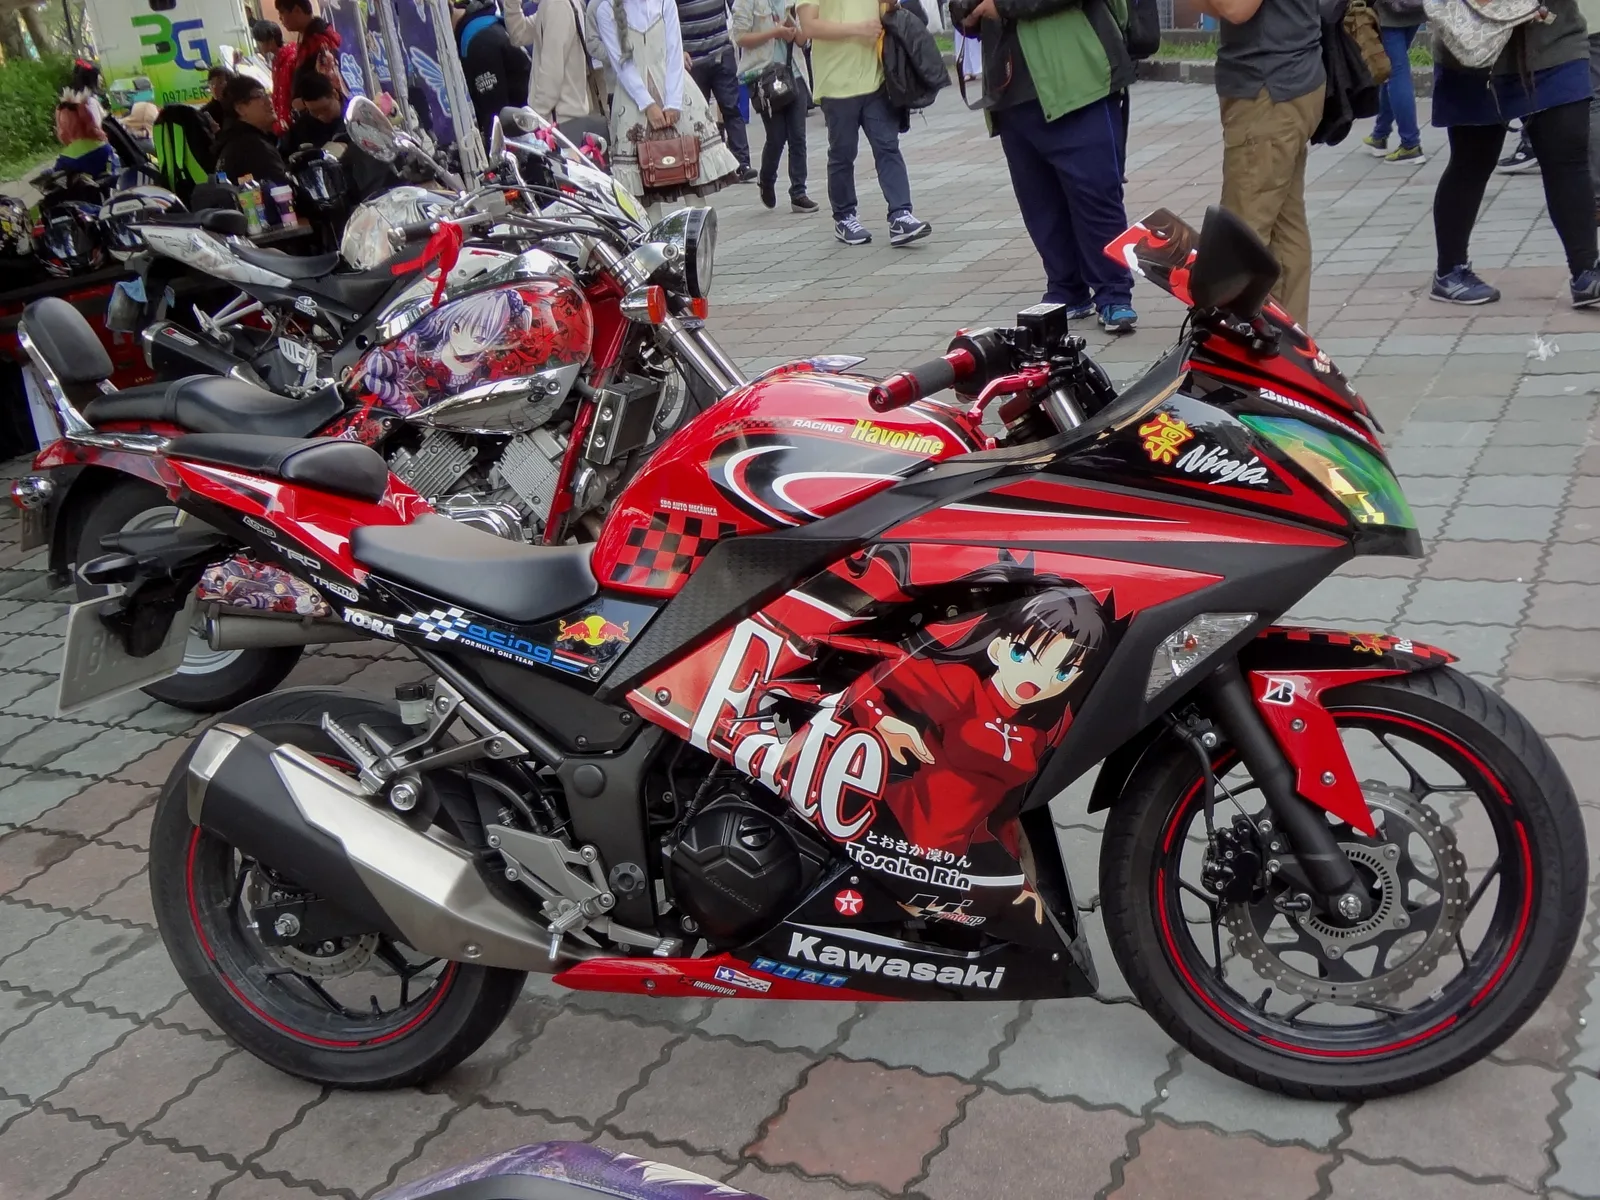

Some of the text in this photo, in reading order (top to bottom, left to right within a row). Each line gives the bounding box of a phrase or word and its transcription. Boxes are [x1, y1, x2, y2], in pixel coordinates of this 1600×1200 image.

[792, 419, 845, 434] RACING
[851, 419, 945, 455] Havoline
[1176, 445, 1269, 485] Ninja
[270, 541, 321, 570] TRD
[344, 607, 396, 637] TOORA
[460, 637, 534, 666] FORMULA ONE TEAM
[690, 618, 886, 840] Fate
[845, 840, 972, 891] Tosaka Rin
[788, 931, 1006, 989] Kawasaki
